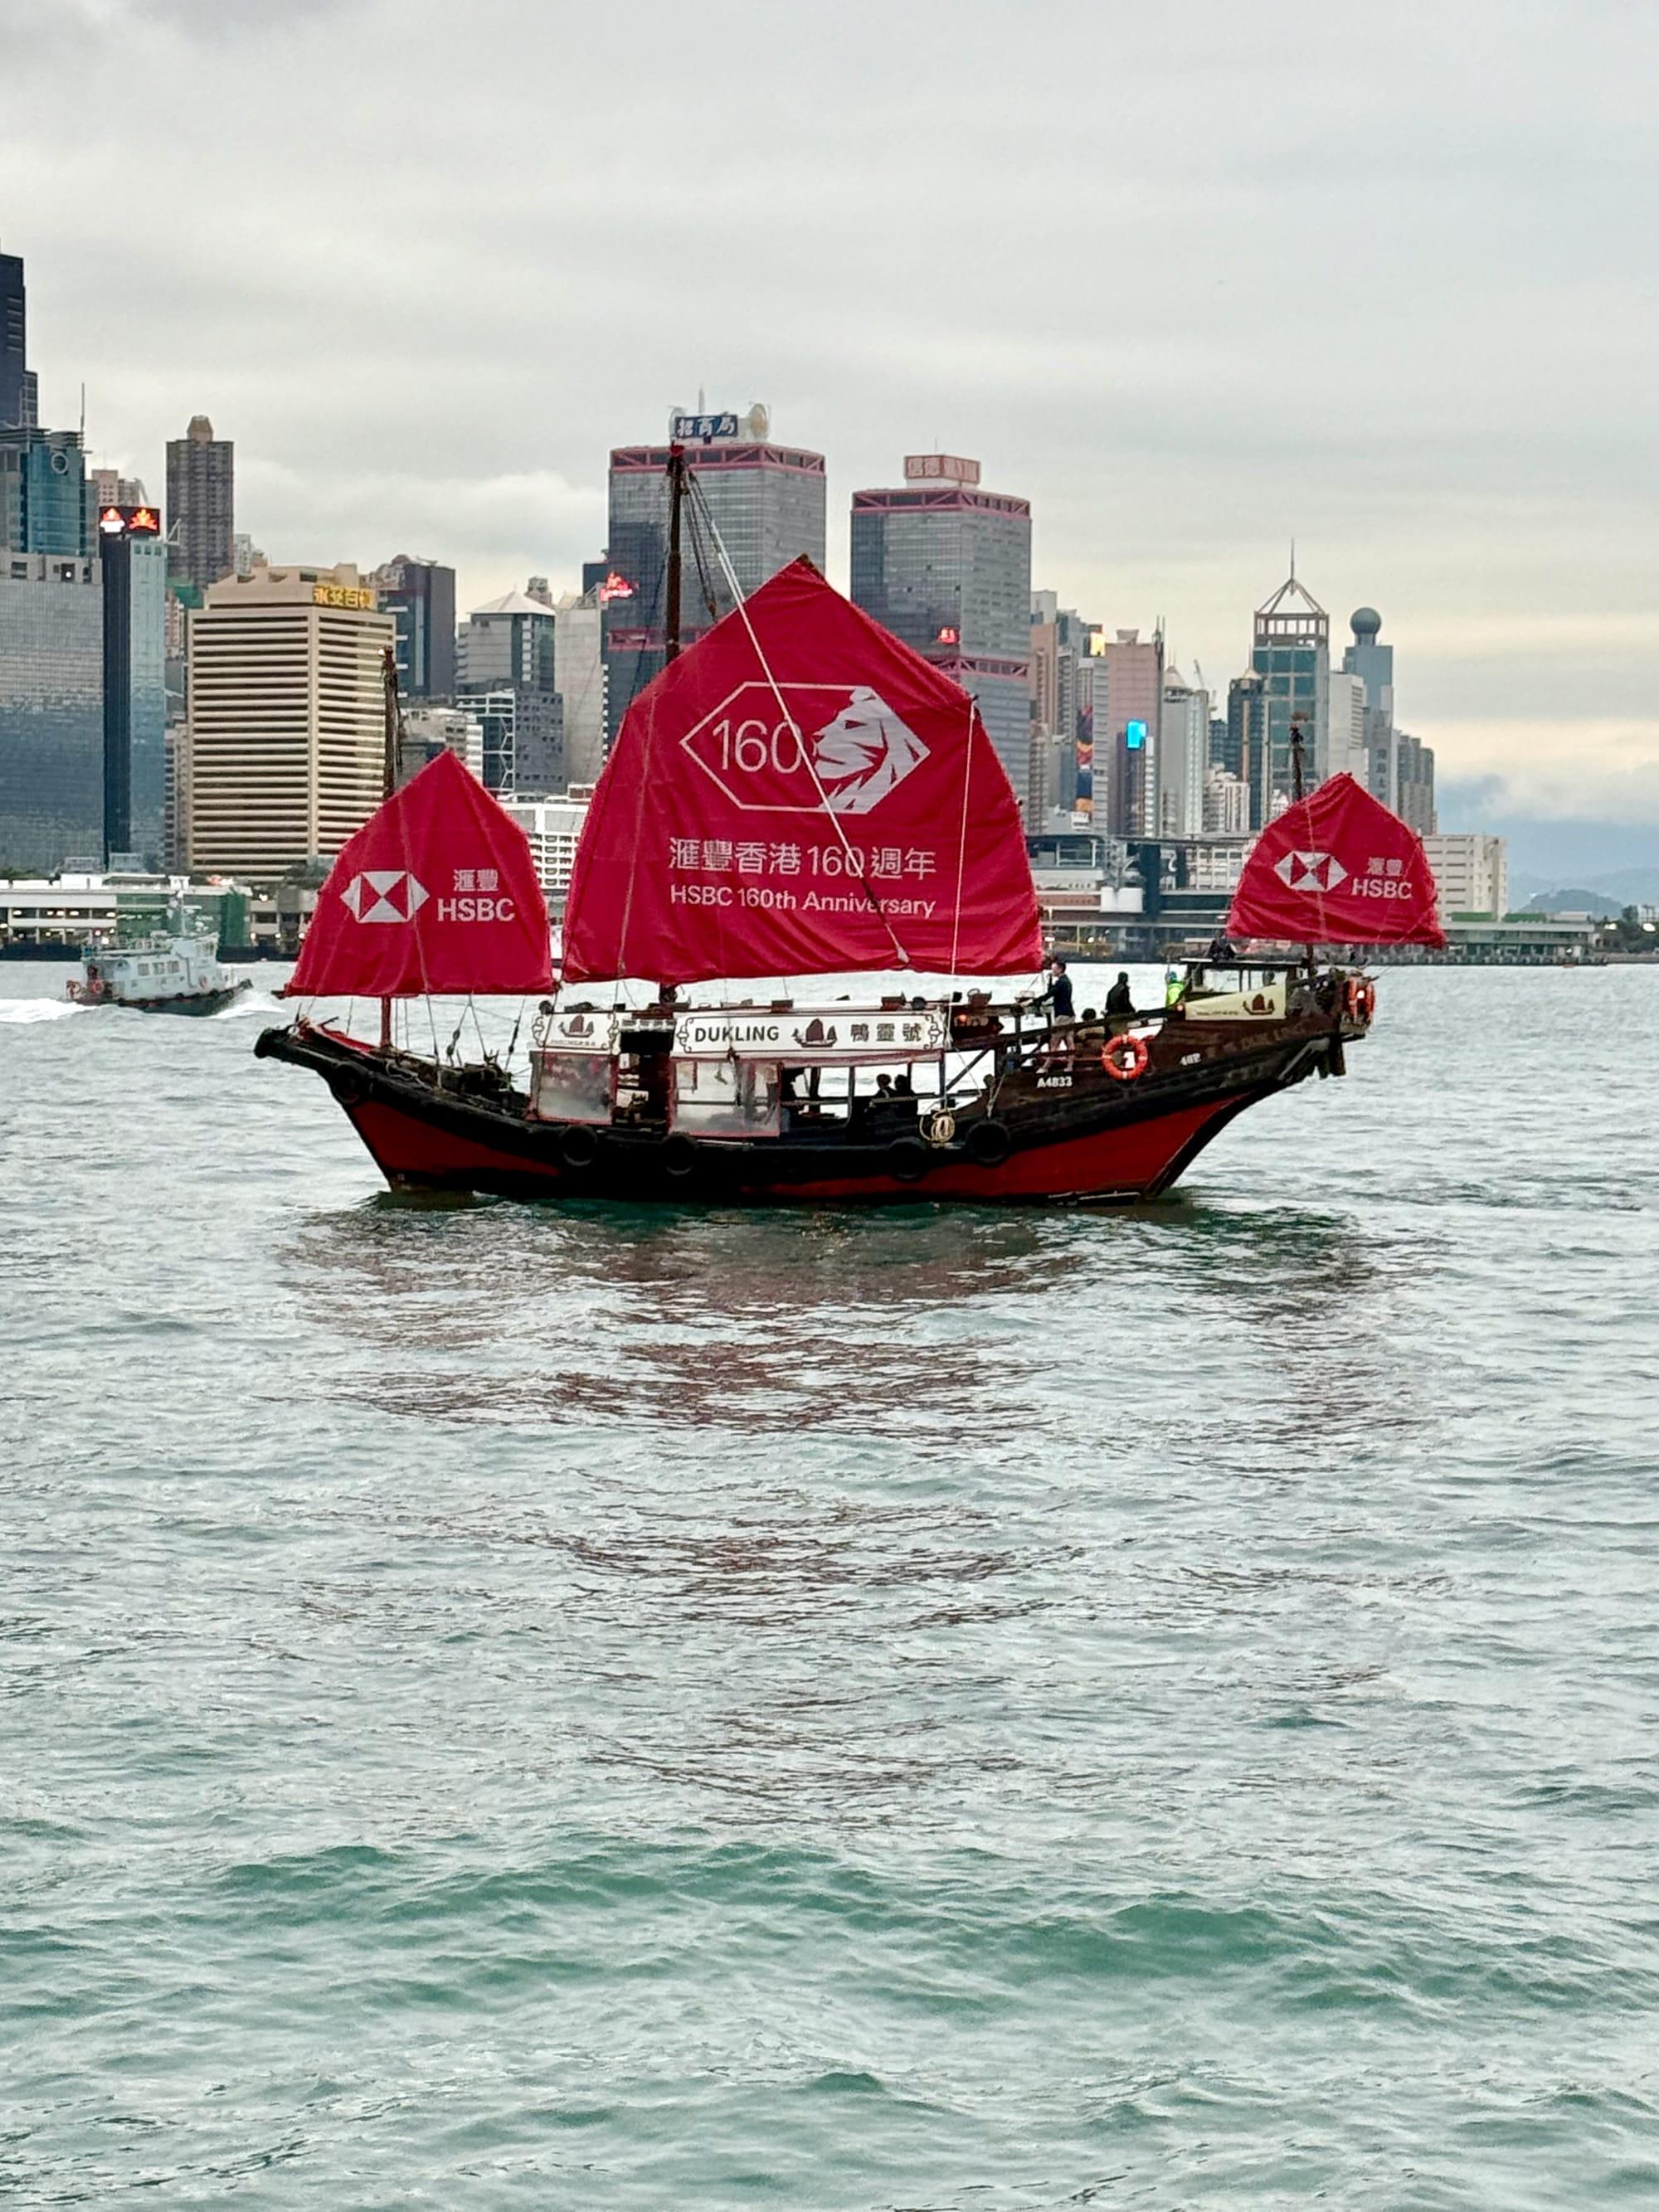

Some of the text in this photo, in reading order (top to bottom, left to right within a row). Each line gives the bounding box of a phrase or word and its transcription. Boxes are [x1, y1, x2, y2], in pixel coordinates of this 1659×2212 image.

[677, 416, 735, 436] 招商局
[713, 719, 803, 774] 160
[1351, 878, 1413, 900] HSBC
[437, 898, 515, 922] HSBC
[671, 884, 936, 919] HSBC 160th Anniversary
